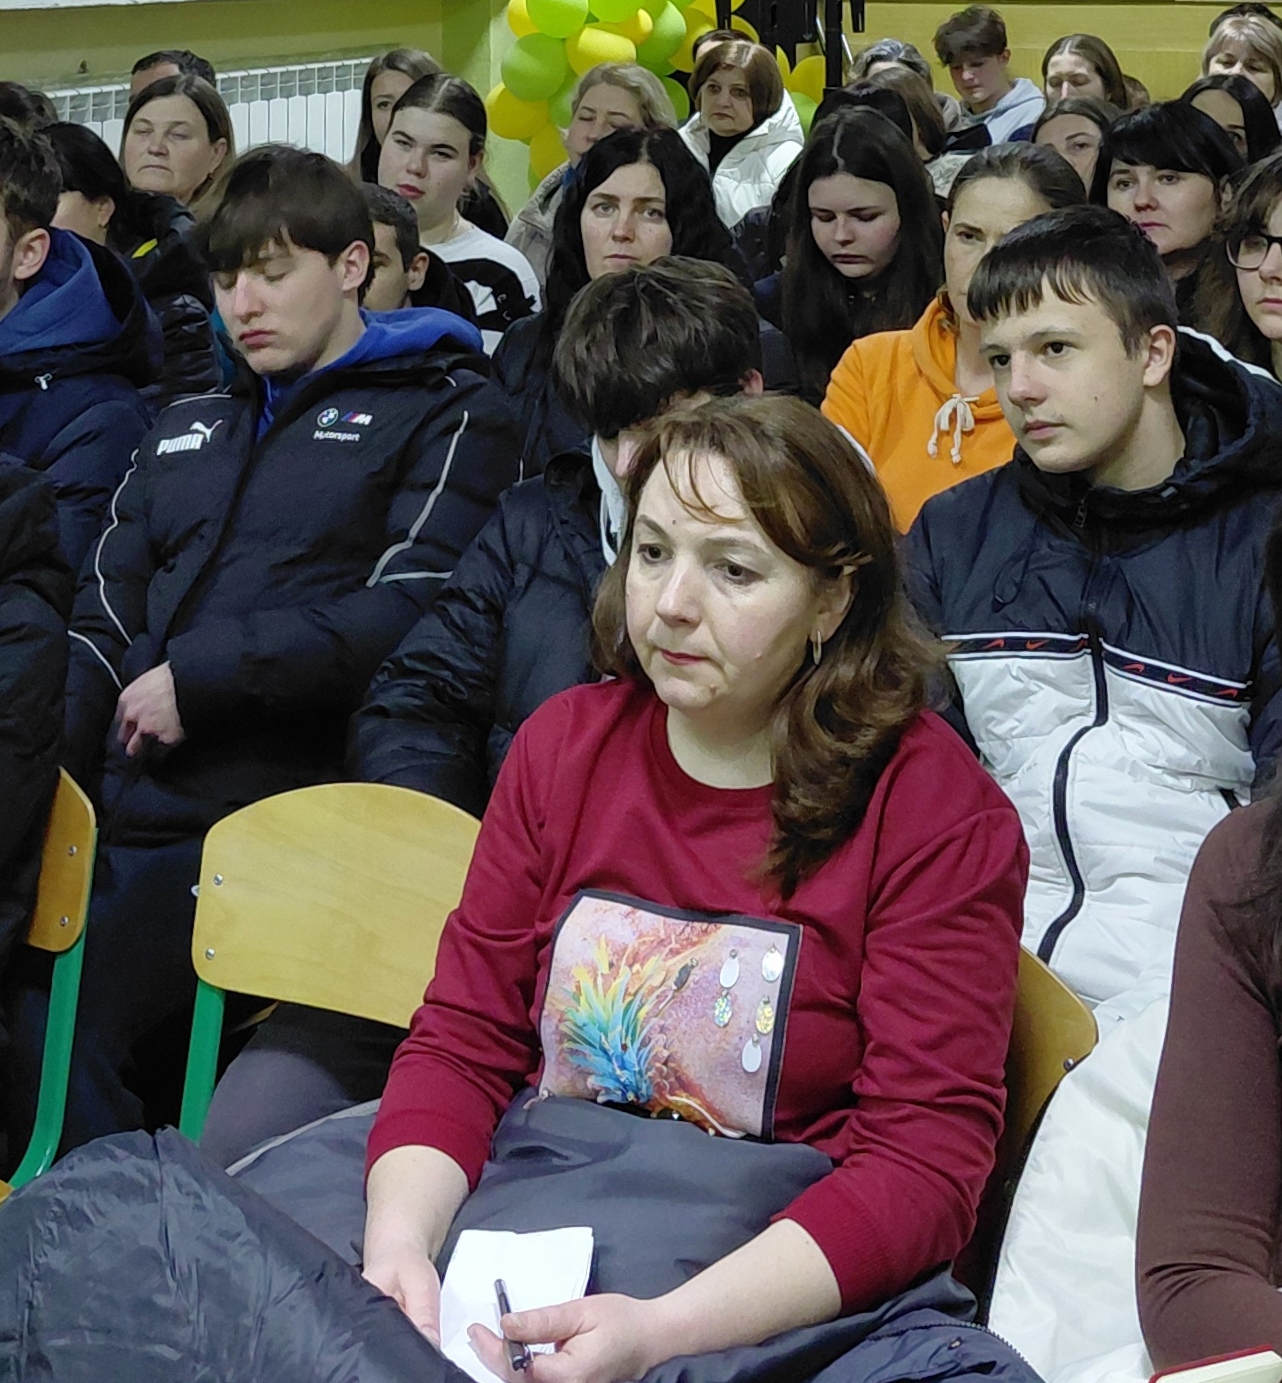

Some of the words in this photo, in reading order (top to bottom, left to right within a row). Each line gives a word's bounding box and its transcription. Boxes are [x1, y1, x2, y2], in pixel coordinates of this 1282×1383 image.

[349, 413, 373, 425] M
[313, 430, 360, 442] Motorsport
[156, 433, 204, 456] PUMA
